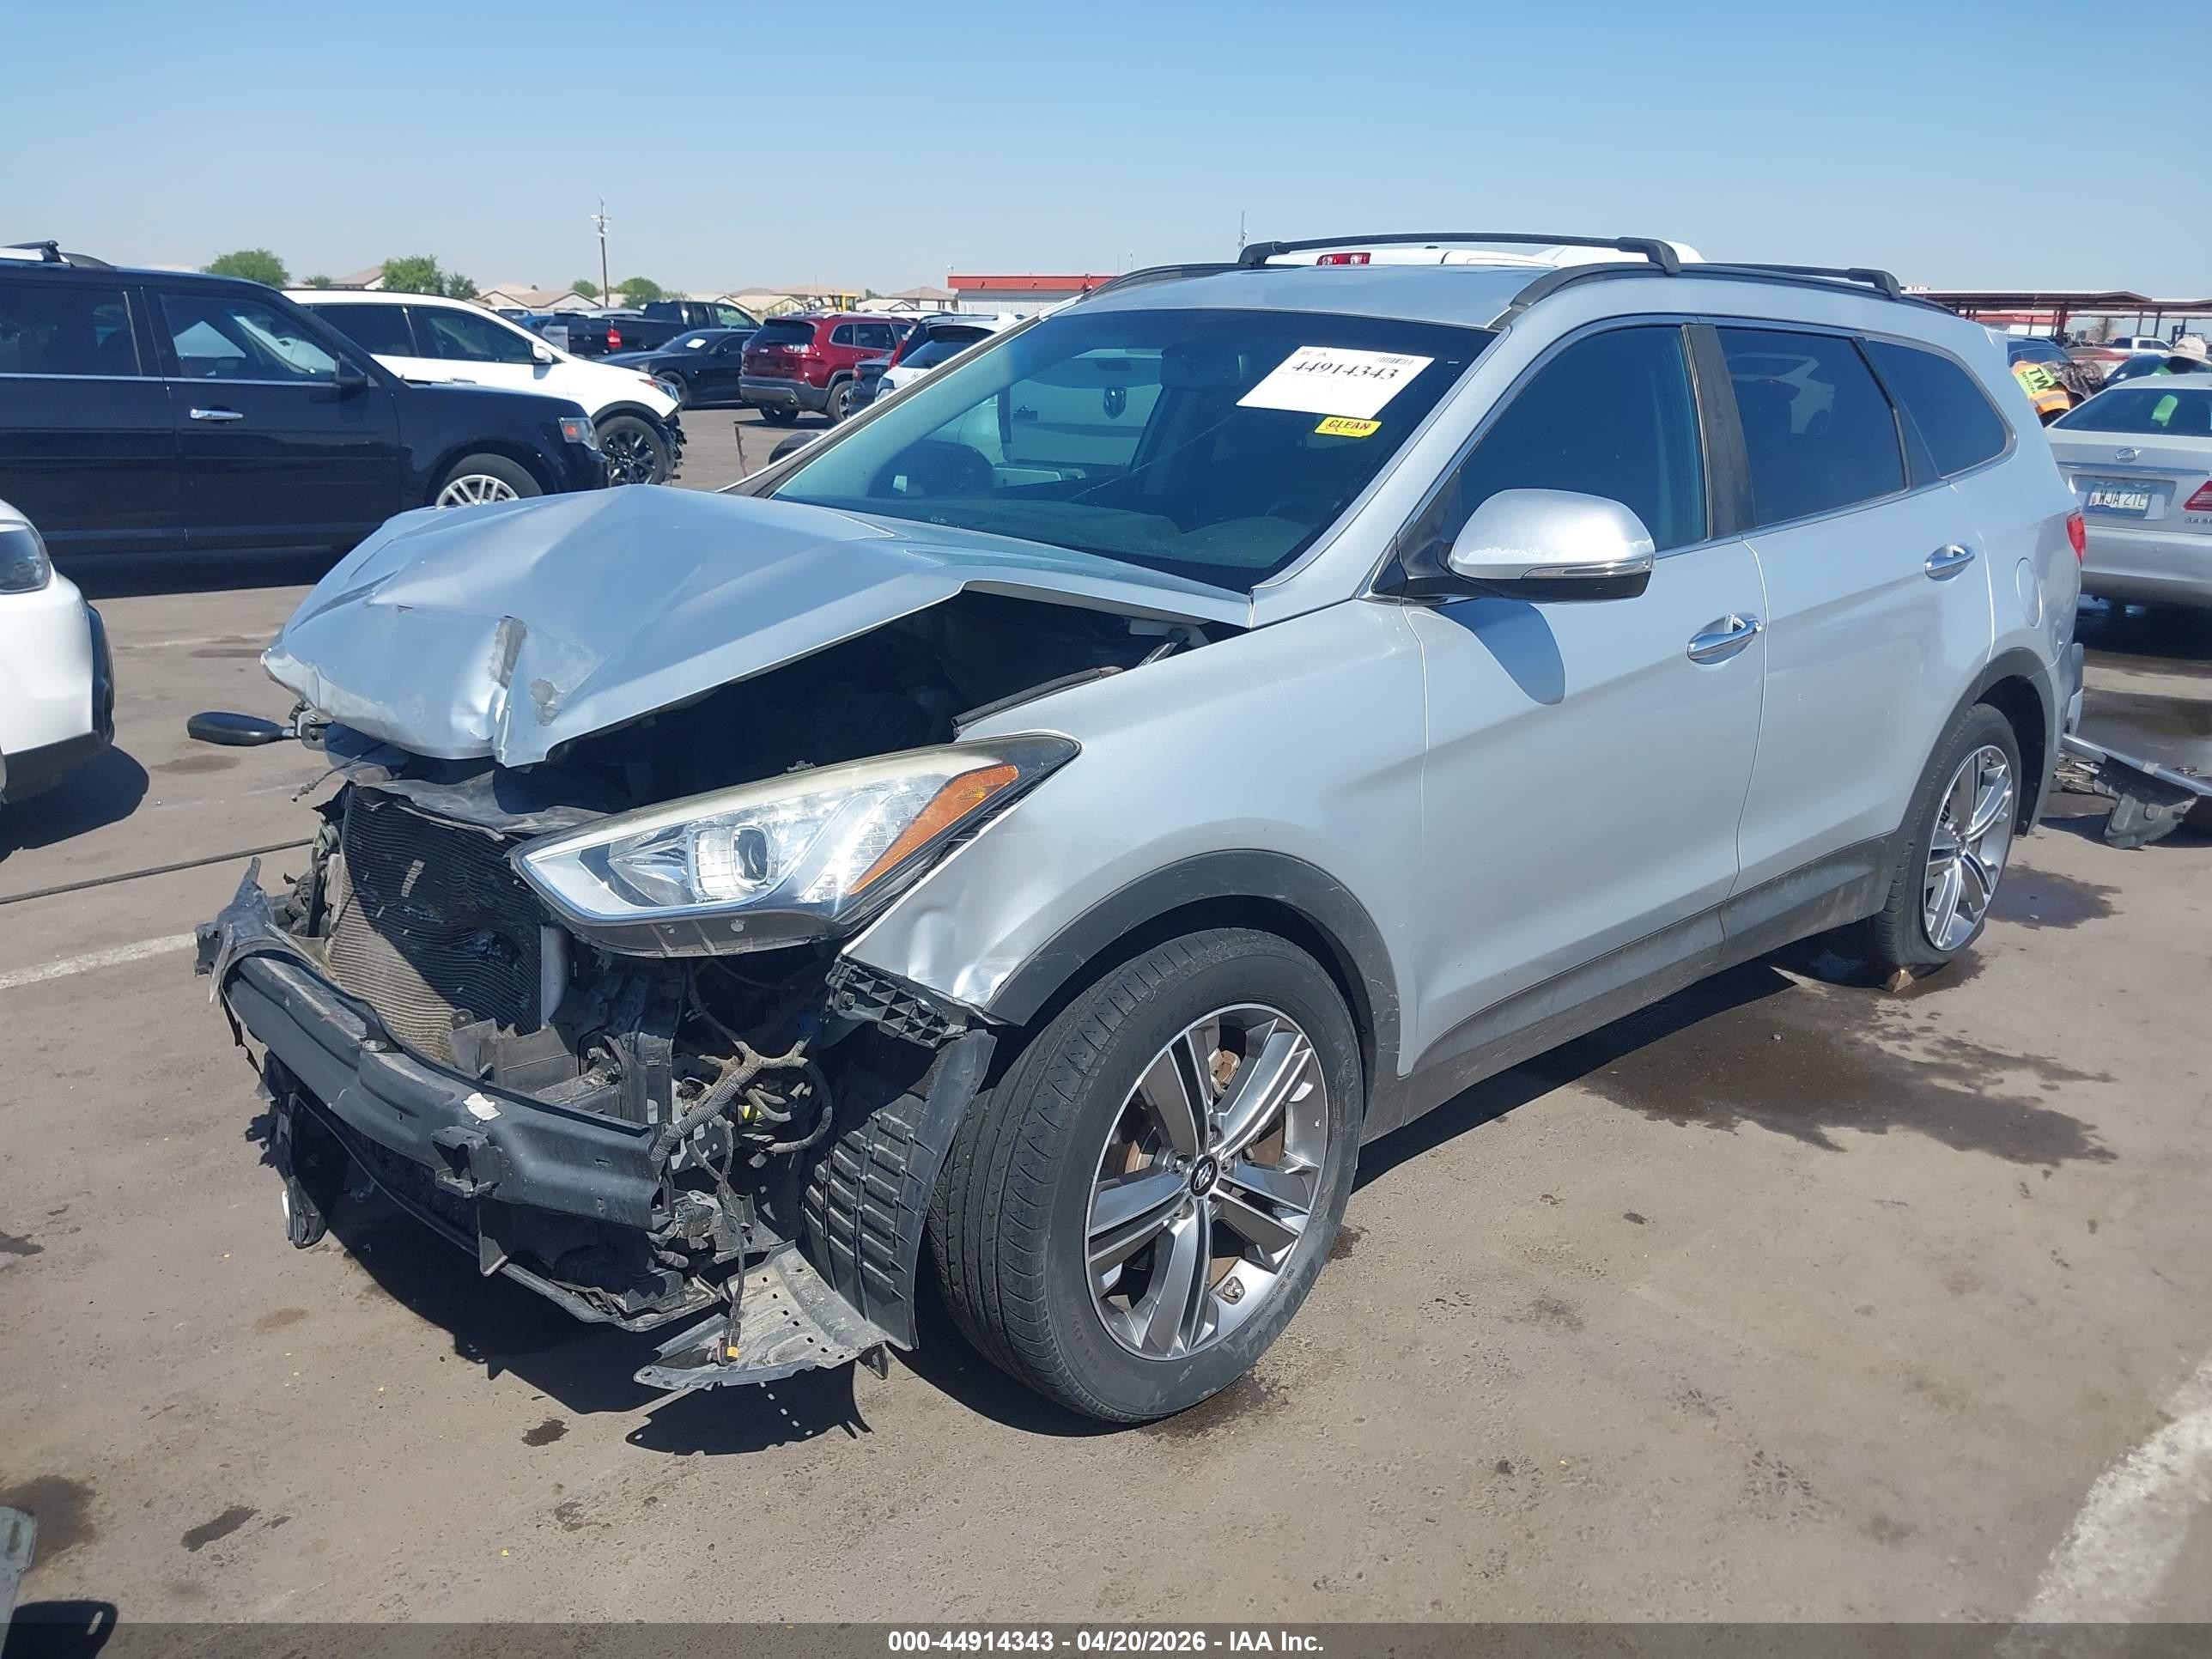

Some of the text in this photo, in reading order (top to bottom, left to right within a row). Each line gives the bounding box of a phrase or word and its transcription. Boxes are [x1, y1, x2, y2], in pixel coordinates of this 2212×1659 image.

[1291, 361, 1400, 380] 44914343
[2028, 367, 2052, 390] TW
[1328, 419, 1371, 430] CLEAN
